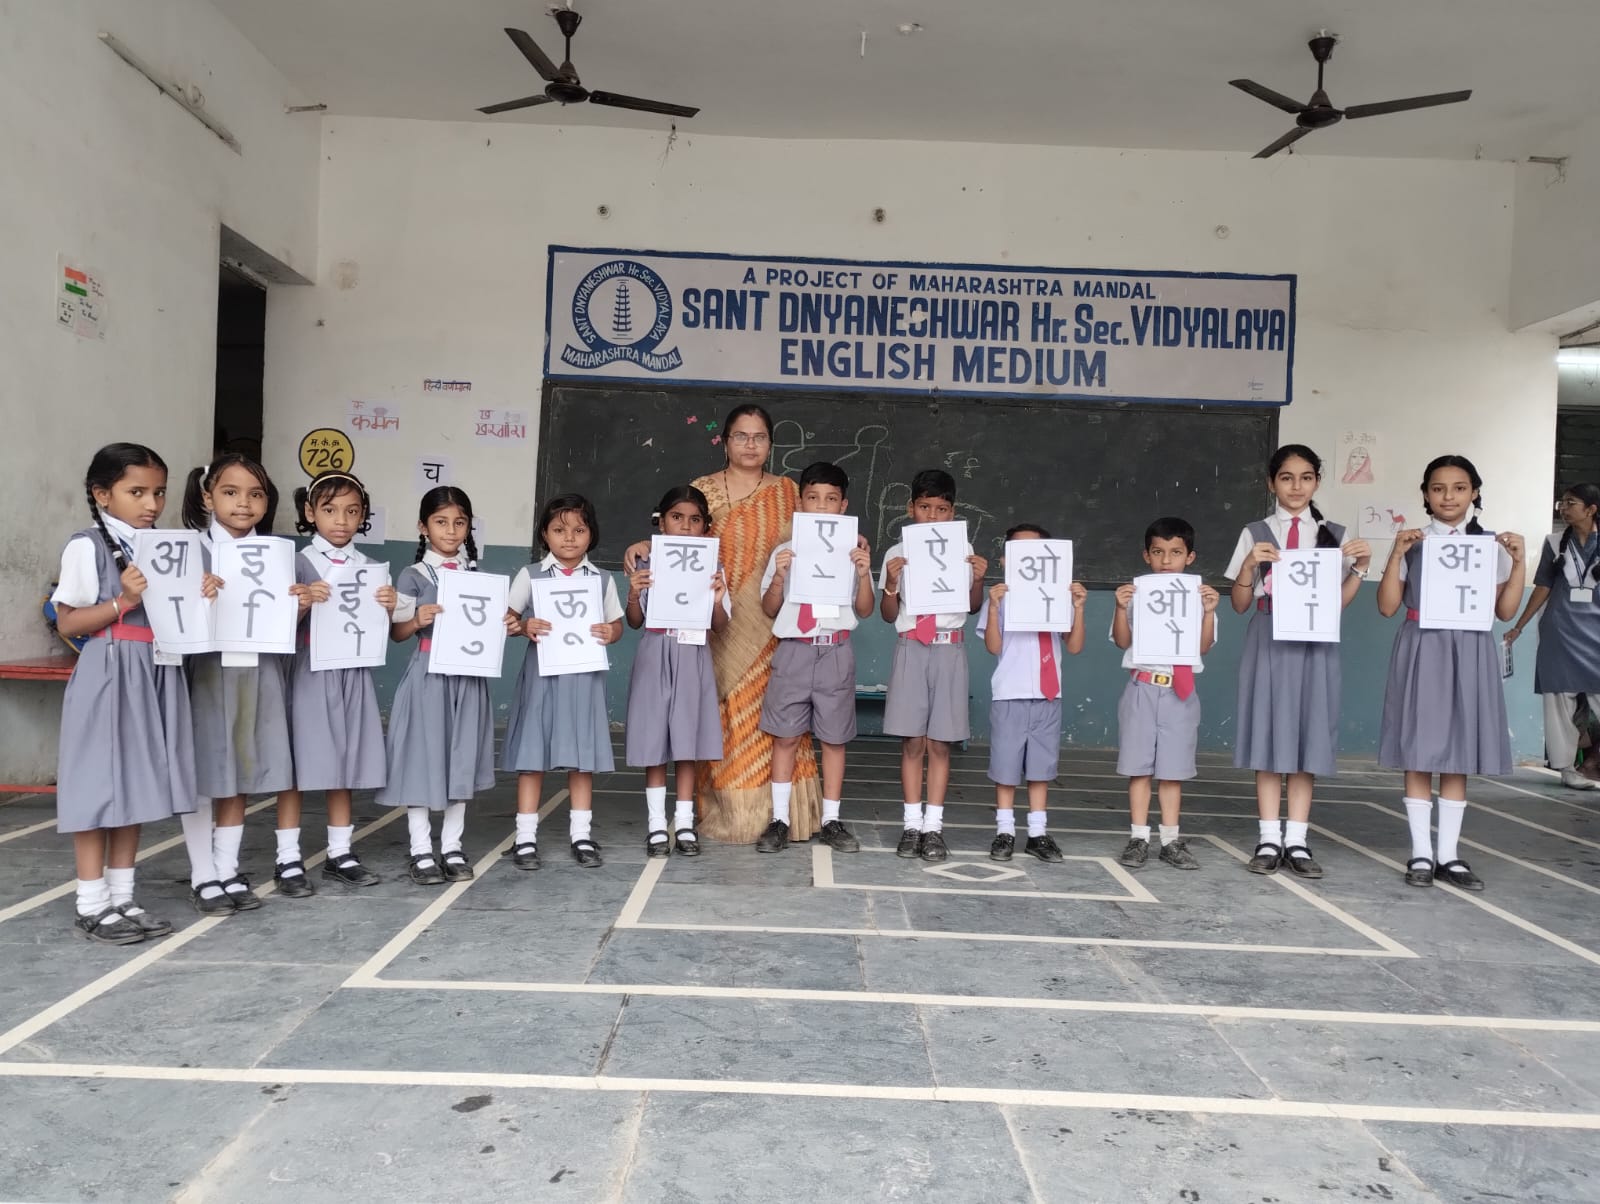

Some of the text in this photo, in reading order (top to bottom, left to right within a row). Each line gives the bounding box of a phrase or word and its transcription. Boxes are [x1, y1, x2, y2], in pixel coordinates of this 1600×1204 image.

[574, 263, 625, 313] DNYANESHWAR
[742, 267, 1156, 299] A PROJECT OF MAHARASHTRA MANDAL
[575, 317, 597, 344] SANT
[650, 283, 670, 340] VIDYALAYA
[682, 288, 1285, 351] SANT DNYANESHWAR Hr. Sec. VIDYALAYA
[563, 346, 681, 369] MAHARASHTRA MANDAL
[780, 338, 1106, 387] ENGLISH MEDIUM
[307, 448, 344, 469] 726
[422, 462, 444, 483] च
[814, 519, 839, 553] ए
[925, 528, 949, 570] ऐ
[236, 544, 270, 586] इ
[1018, 543, 1061, 584] ओ
[337, 569, 368, 620] ई
[458, 593, 491, 627] उ
[550, 589, 588, 619] ऊ
[1147, 578, 1191, 618] औ
